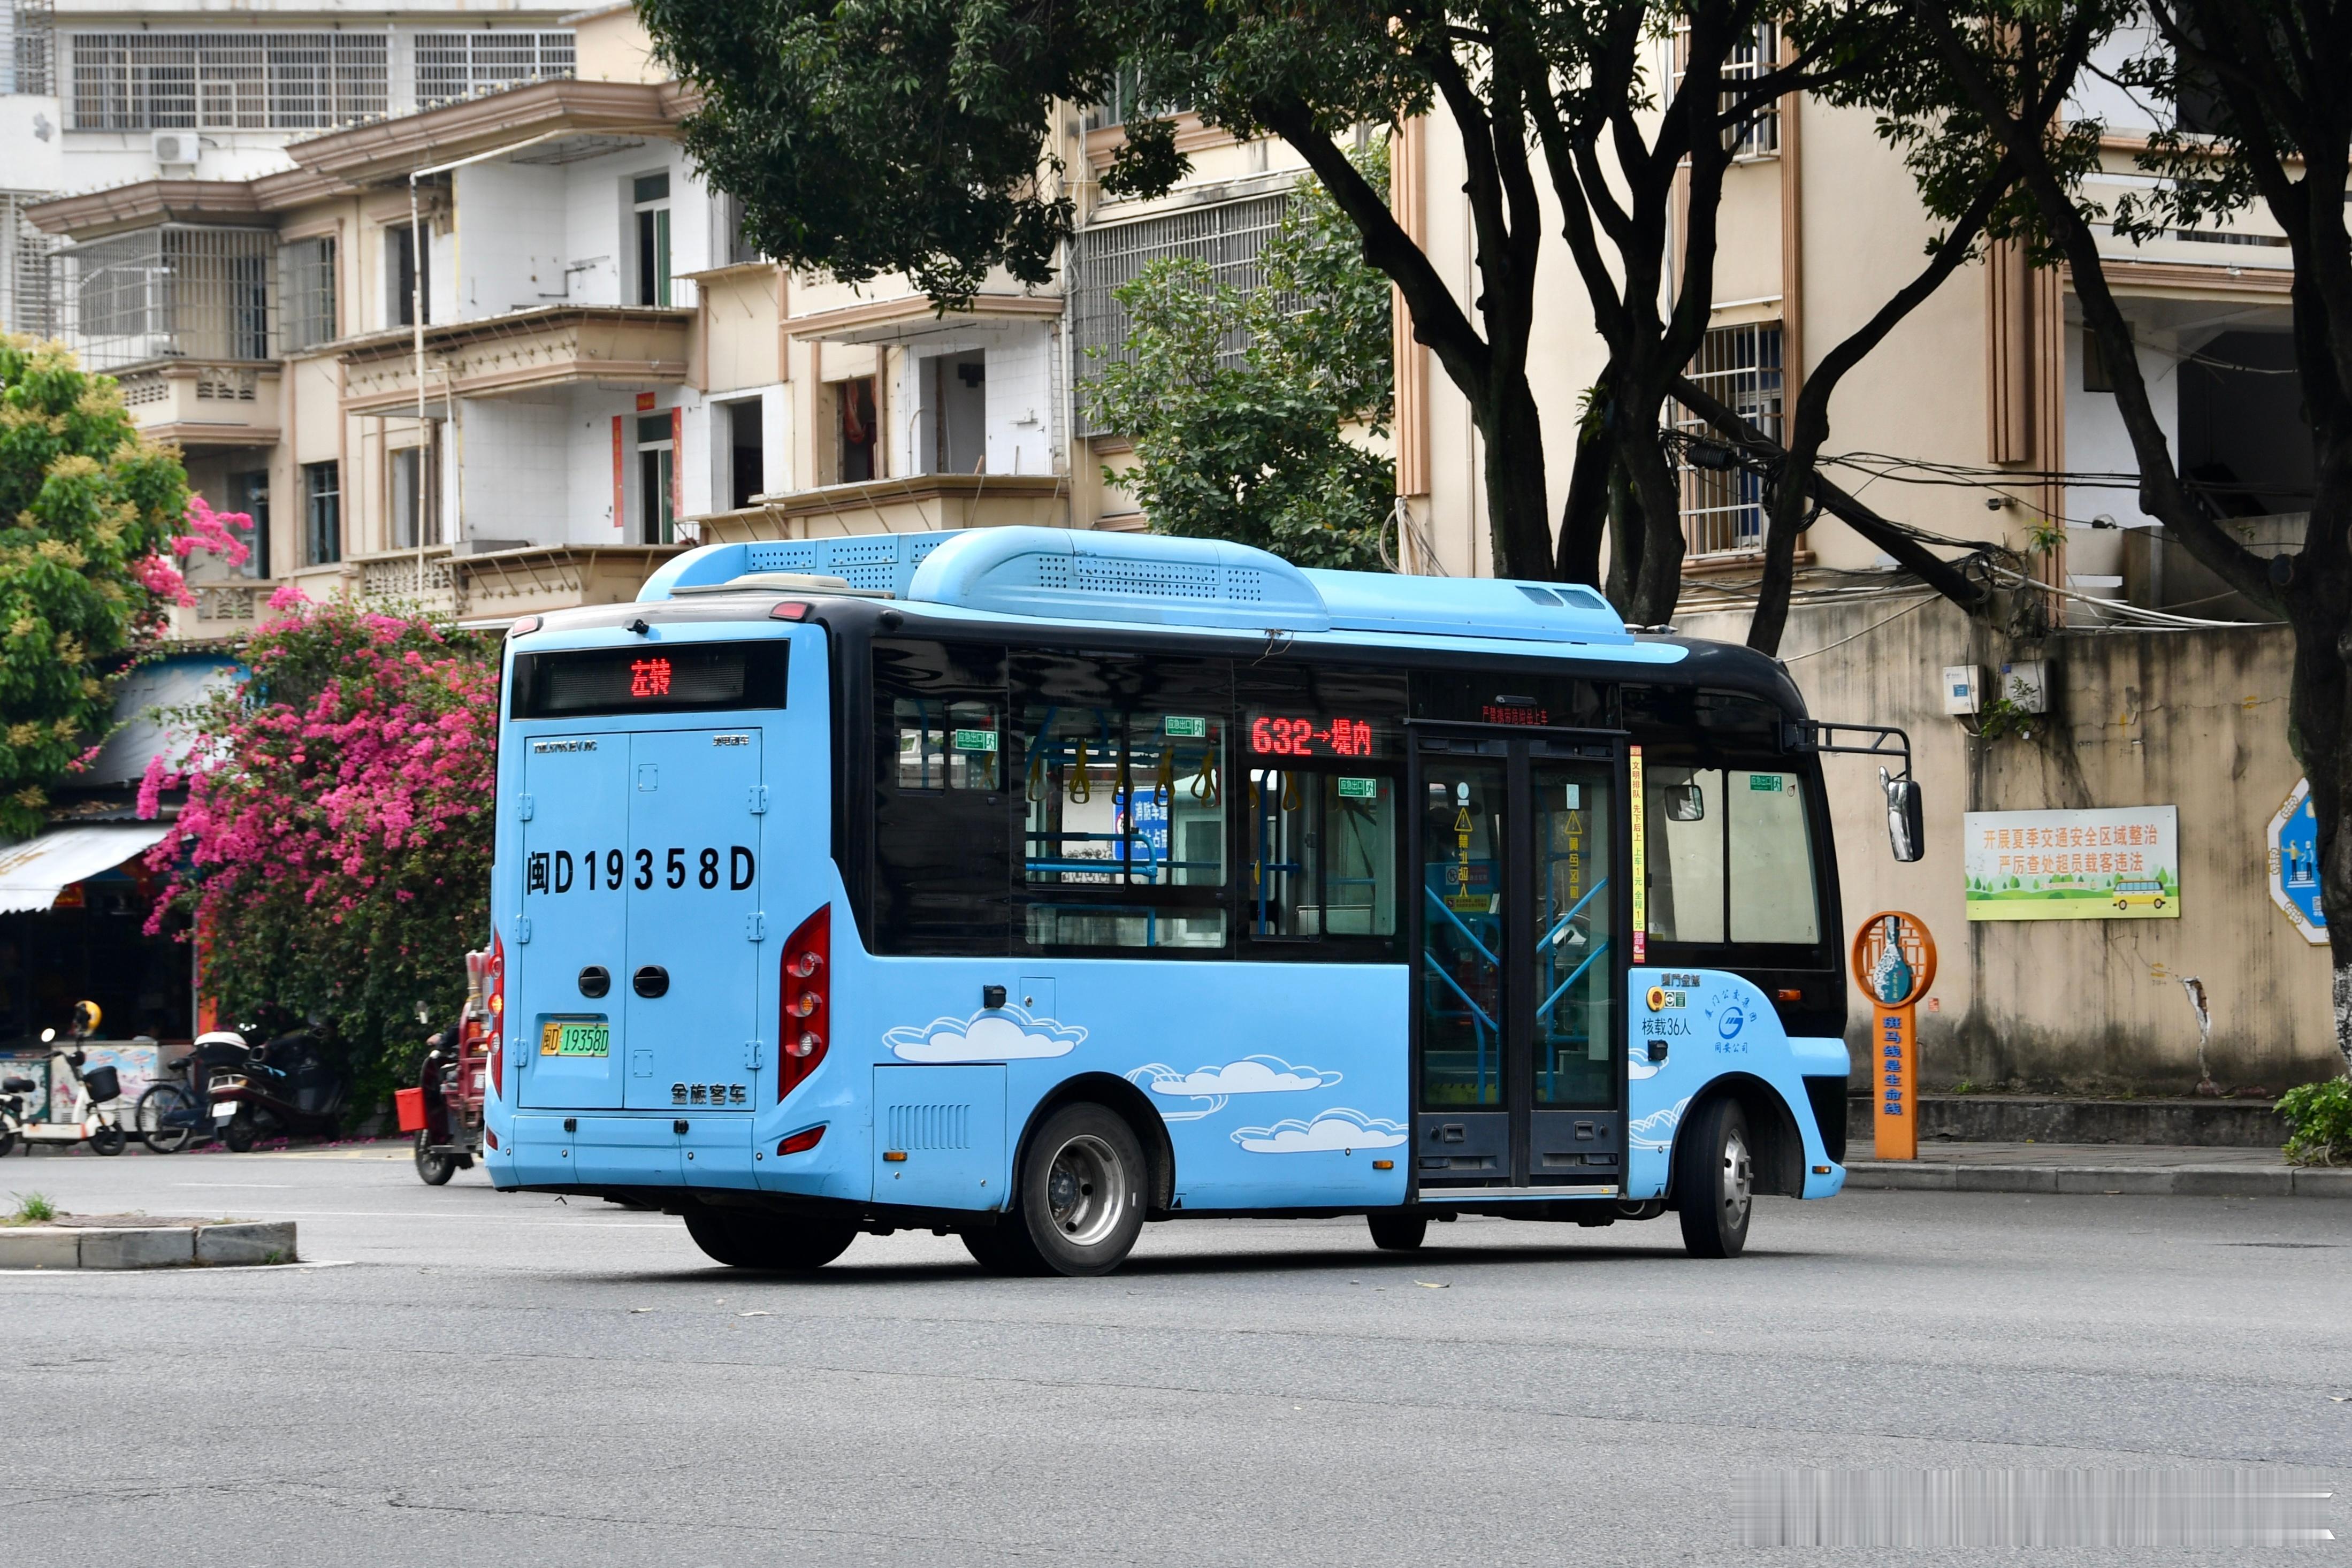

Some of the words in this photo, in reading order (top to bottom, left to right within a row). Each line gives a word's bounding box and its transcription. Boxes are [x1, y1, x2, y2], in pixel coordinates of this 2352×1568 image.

[630, 659, 671, 697] 左转
[1483, 706, 1548, 725] 严禁携带危险品上车
[958, 732, 983, 743] 应急出口
[1253, 717, 1312, 755] 632
[1331, 718, 1371, 755] 堤内
[1340, 779, 1363, 790] 应急出口
[1632, 761, 1641, 798] 文明排队
[1633, 805, 1642, 842] 先下后上
[1983, 824, 2158, 850] 开展夏季交通安全区域整治
[526, 846, 755, 895] 闽D19358D
[1634, 847, 1643, 885] 上车1元
[1999, 851, 2143, 875] 严厉查处超员载客违法
[1635, 891, 1643, 929] 全程1元
[1642, 1018, 1691, 1036] 核载36人
[1715, 1042, 1748, 1053] 同安公司
[1883, 1016, 1903, 1115] 斑马线是生命线
